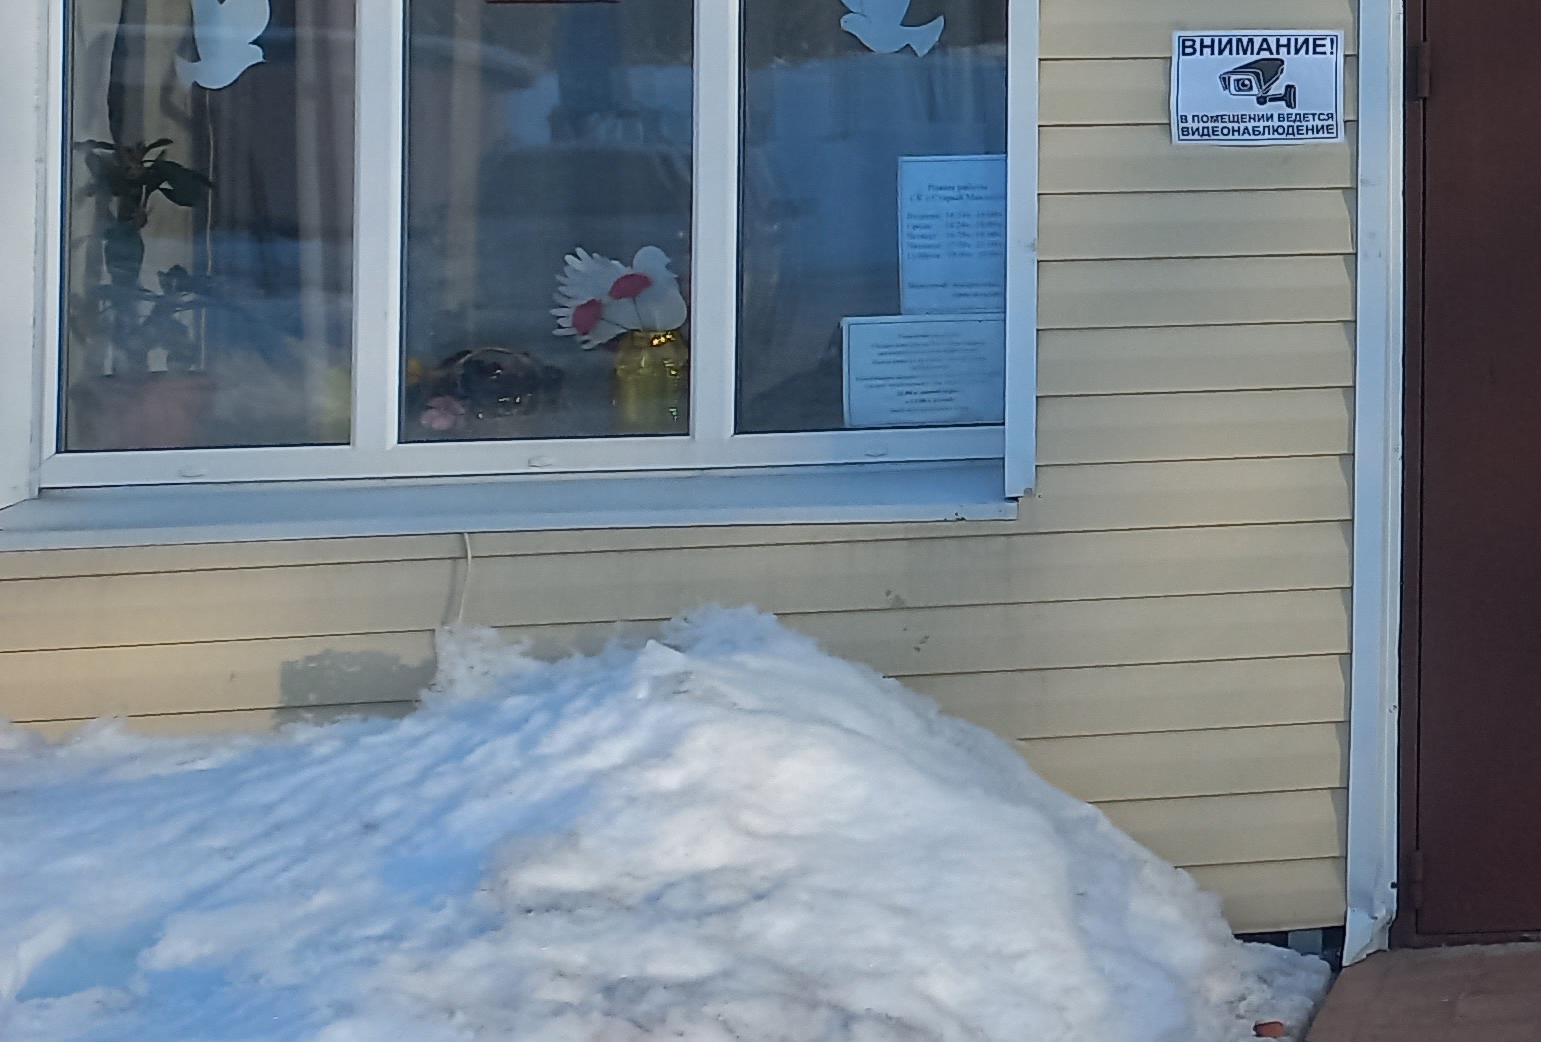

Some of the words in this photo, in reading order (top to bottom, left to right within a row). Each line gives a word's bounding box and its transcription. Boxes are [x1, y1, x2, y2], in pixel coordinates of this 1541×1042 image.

[1181, 37, 1335, 56] ВНИМАНИЕ!
[1278, 113, 1333, 123] ВЕДЕТСЯ
[1181, 124, 1335, 137] ВИДЕОНАБЛЮДЕНИЕ
